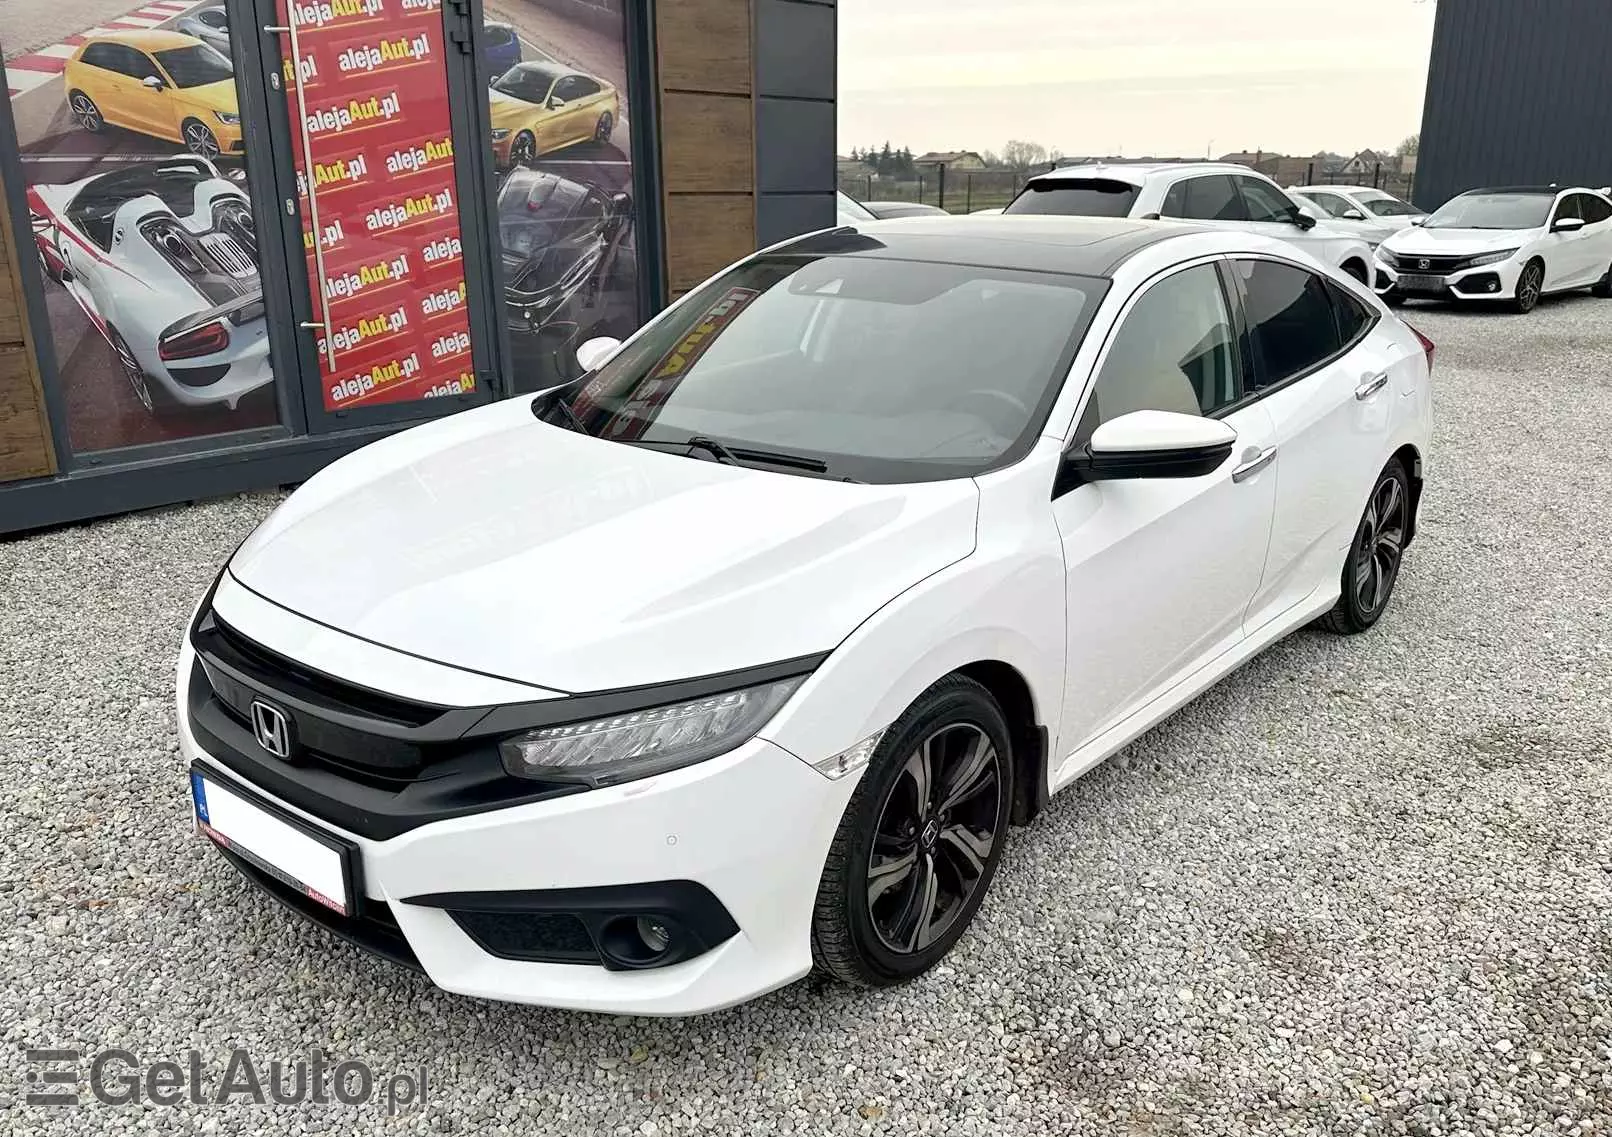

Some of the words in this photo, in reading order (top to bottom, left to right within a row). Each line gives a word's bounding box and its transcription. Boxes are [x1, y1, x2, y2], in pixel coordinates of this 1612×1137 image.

[338, 34, 431, 71] alejaAut.pl
[307, 92, 400, 132] alejaAut.pl
[366, 188, 453, 230] alejaAut.pl
[317, 306, 408, 353] aejaAut.pl
[331, 353, 420, 401] alejaAut.pl
